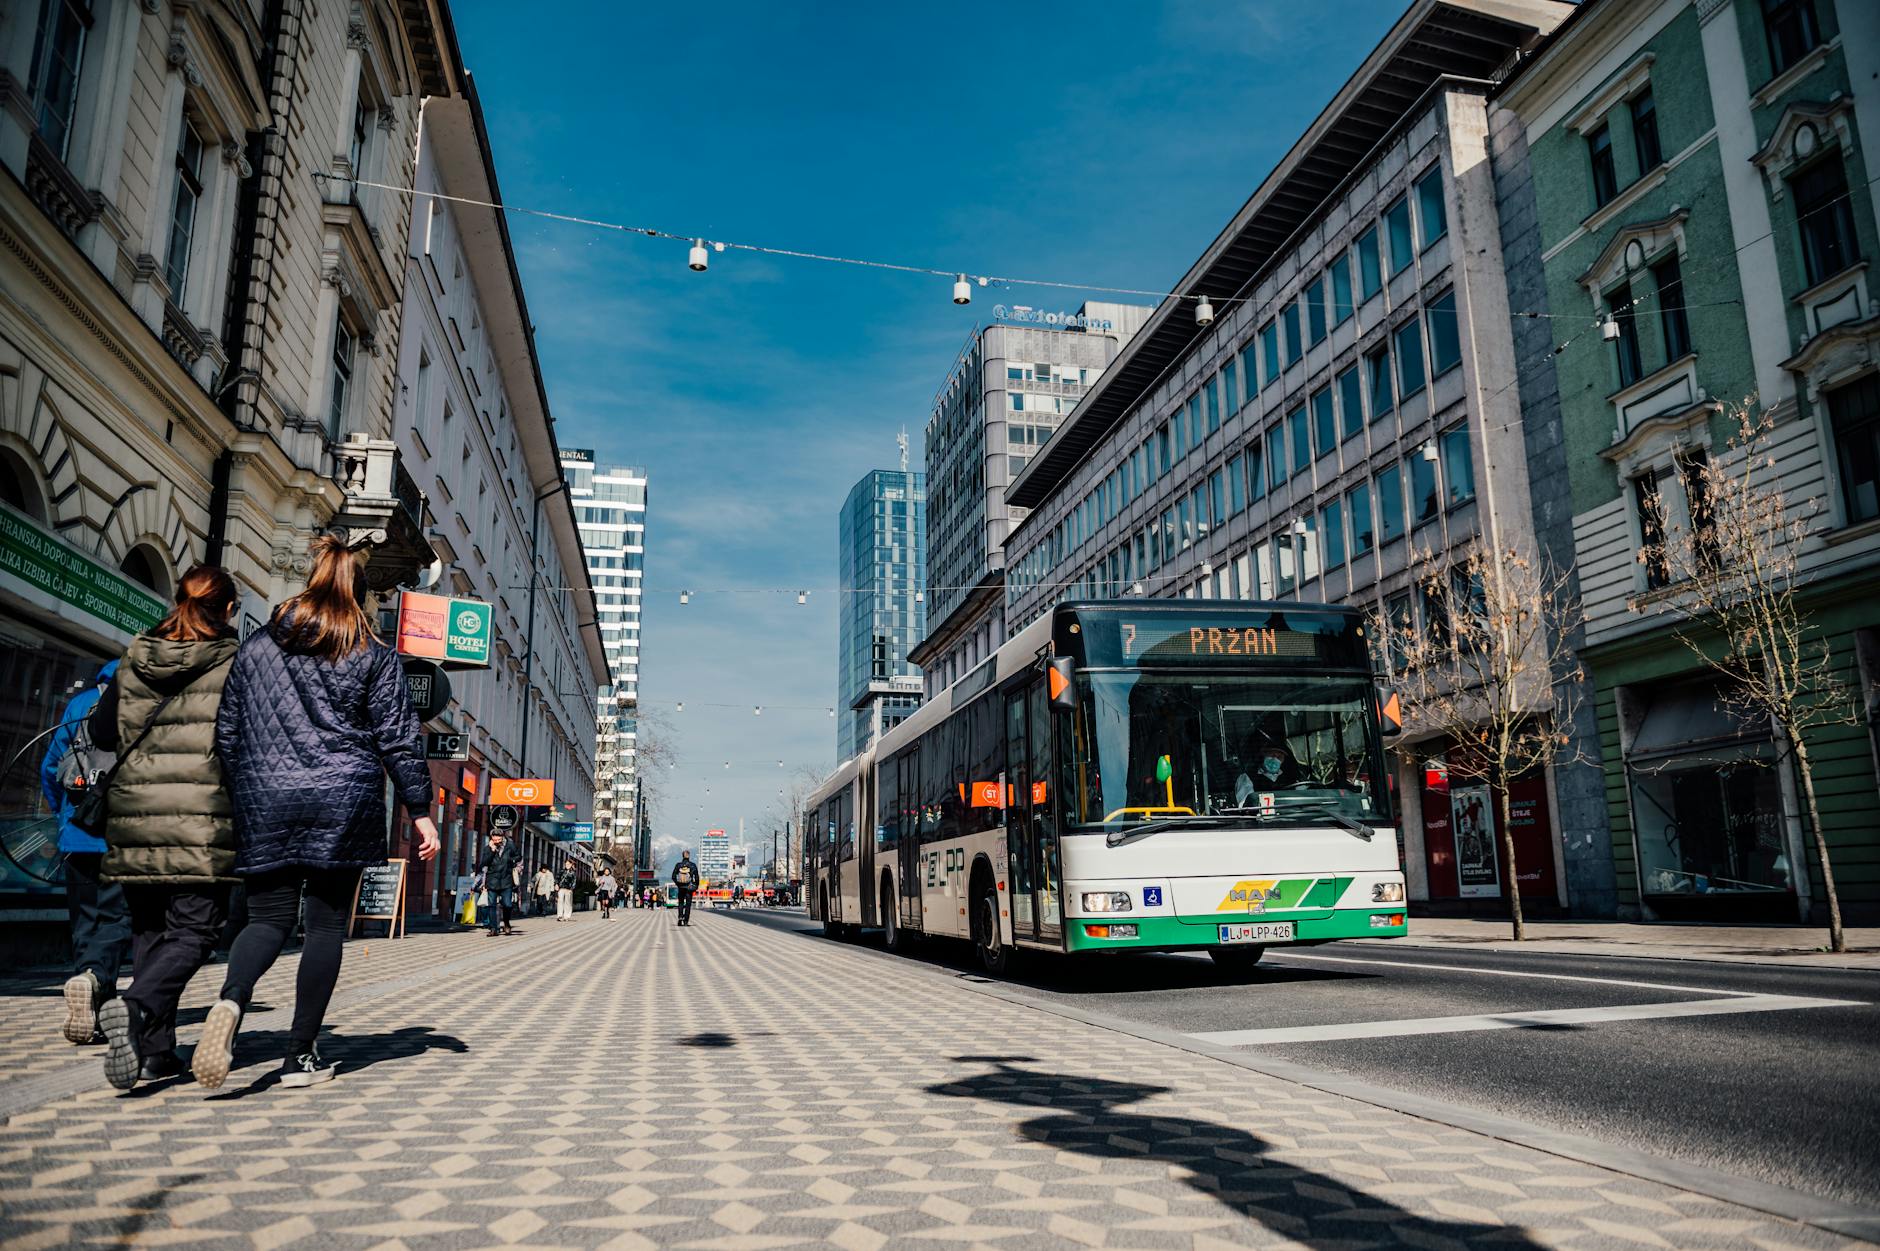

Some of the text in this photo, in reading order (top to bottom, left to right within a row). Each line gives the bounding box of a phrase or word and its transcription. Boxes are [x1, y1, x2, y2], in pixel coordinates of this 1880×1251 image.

[0, 545, 21, 571] LIKA
[22, 560, 51, 587] IZBIRA
[52, 573, 79, 599] ČAJEV
[84, 590, 116, 620] ŠPORTNA
[43, 541, 88, 579] DOPOLNILA
[94, 571, 128, 600] NARAVNA
[127, 591, 162, 619] KOZMETIKA
[449, 635, 486, 648] HOTEL
[1121, 624, 1136, 655] 7
[454, 644, 480, 652] CENTER
[1229, 888, 1281, 902] MAN
[1229, 927, 1242, 940] LJ
